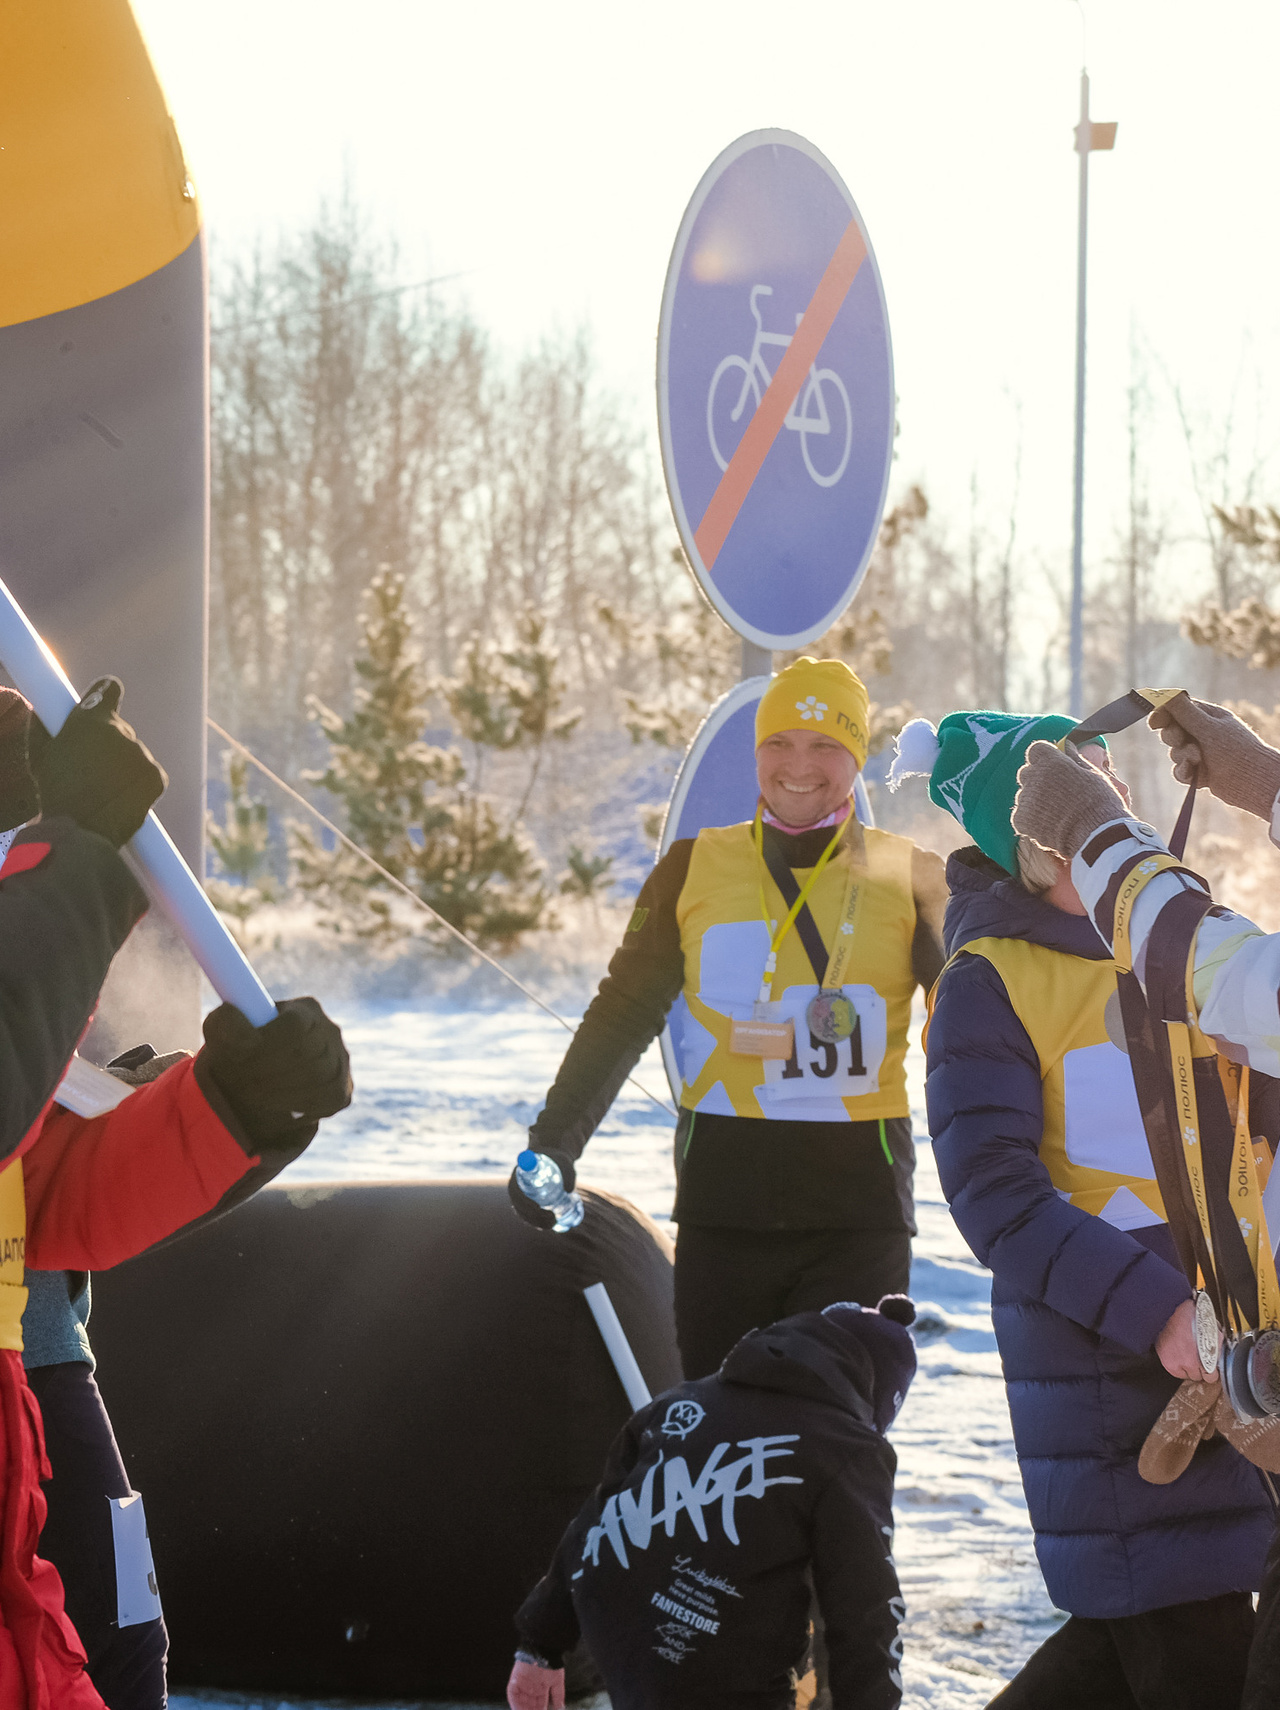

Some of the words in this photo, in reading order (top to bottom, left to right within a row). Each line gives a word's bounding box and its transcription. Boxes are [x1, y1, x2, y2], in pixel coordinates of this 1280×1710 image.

[837, 711, 867, 759] ПОЛ
[1177, 1055, 1192, 1120] ПОЛЮС
[650, 1592, 720, 1636] FANYESTORE
